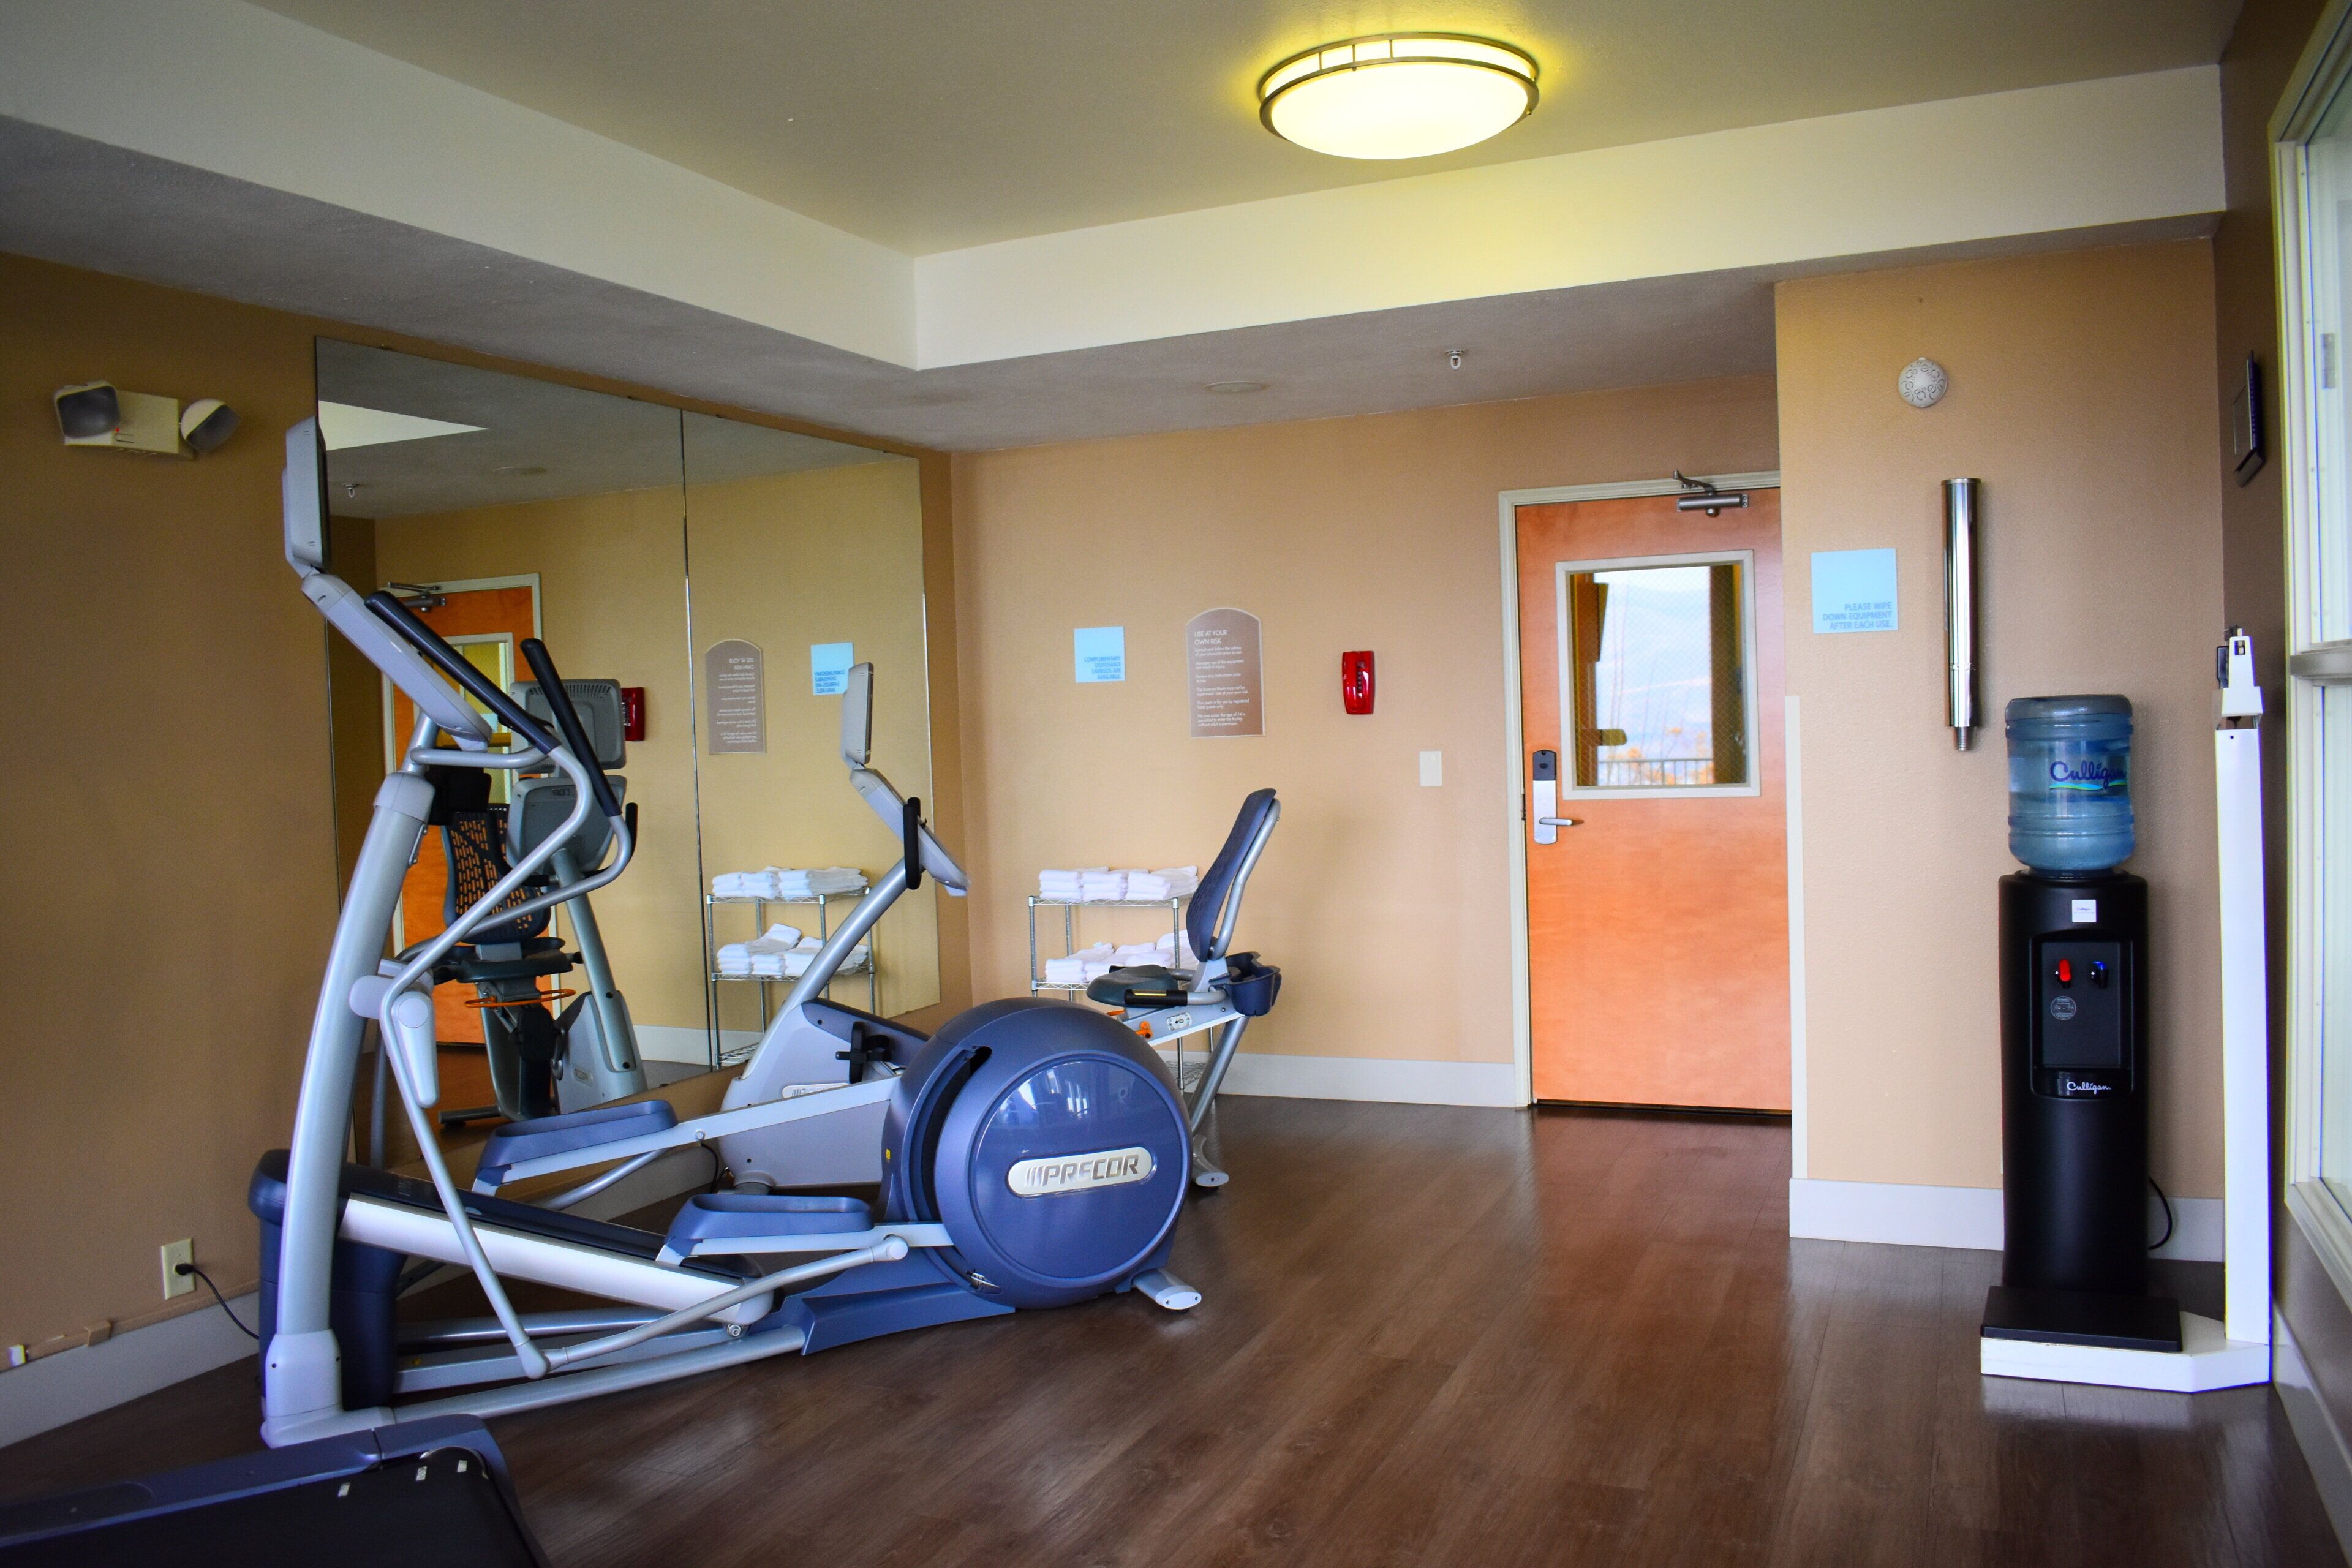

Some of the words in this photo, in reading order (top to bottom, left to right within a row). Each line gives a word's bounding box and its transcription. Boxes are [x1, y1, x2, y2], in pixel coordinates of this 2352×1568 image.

[1849, 611, 1892, 620] EQUIPMENT
[1875, 619, 1893, 628] USE.
[2050, 760, 2127, 790] Culligan
[1042, 1154, 1139, 1186] PRECOR
